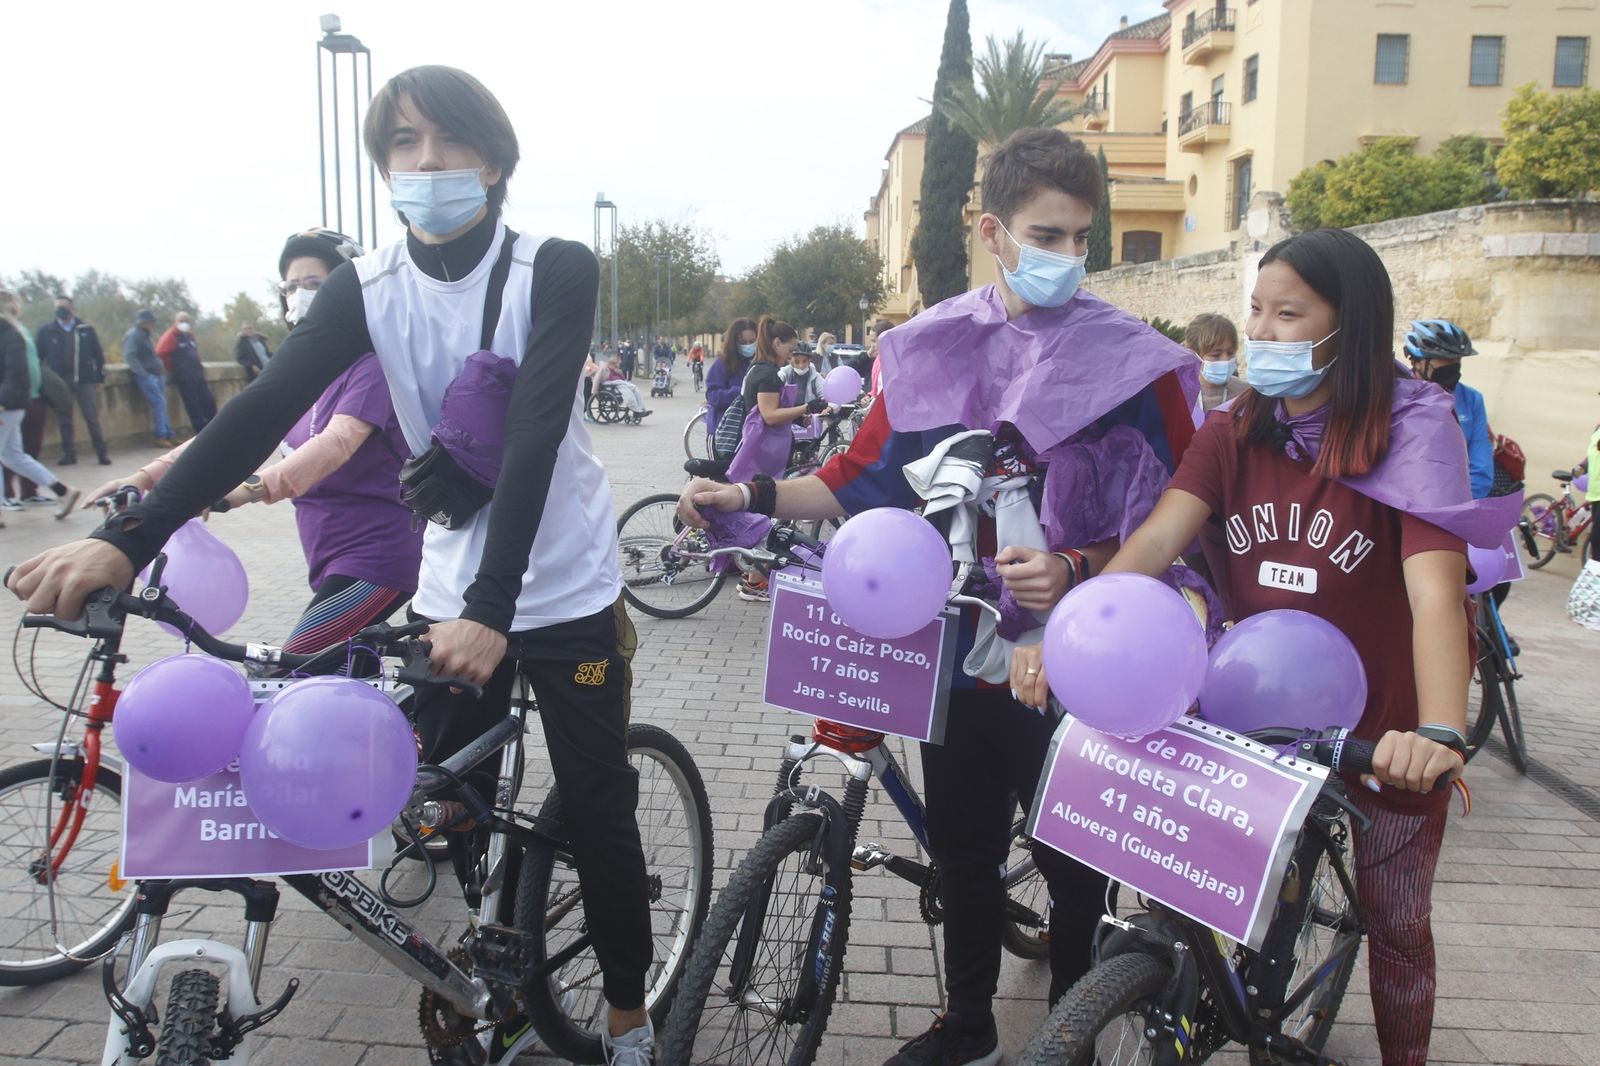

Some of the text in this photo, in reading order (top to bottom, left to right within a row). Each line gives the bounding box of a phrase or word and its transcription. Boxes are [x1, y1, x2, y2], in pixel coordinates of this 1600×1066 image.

[1225, 502, 1375, 574] UNION
[1271, 567, 1305, 587] TEAM
[806, 604, 850, 628] 11 d
[782, 622, 931, 669] Rocío Caíz Pozo,
[811, 656, 879, 684] 17 años
[793, 682, 825, 699] Jara
[838, 691, 890, 714] Sevilla
[1079, 738, 1255, 836] Nicoleta Clara,
[1146, 738, 1248, 790] de mayo
[174, 783, 248, 809] María
[1100, 787, 1191, 842] 41 años
[200, 819, 281, 841] Barri
[1050, 801, 1246, 906] Alovera (Guadalajara)
[313, 870, 410, 945] OPBIKE
